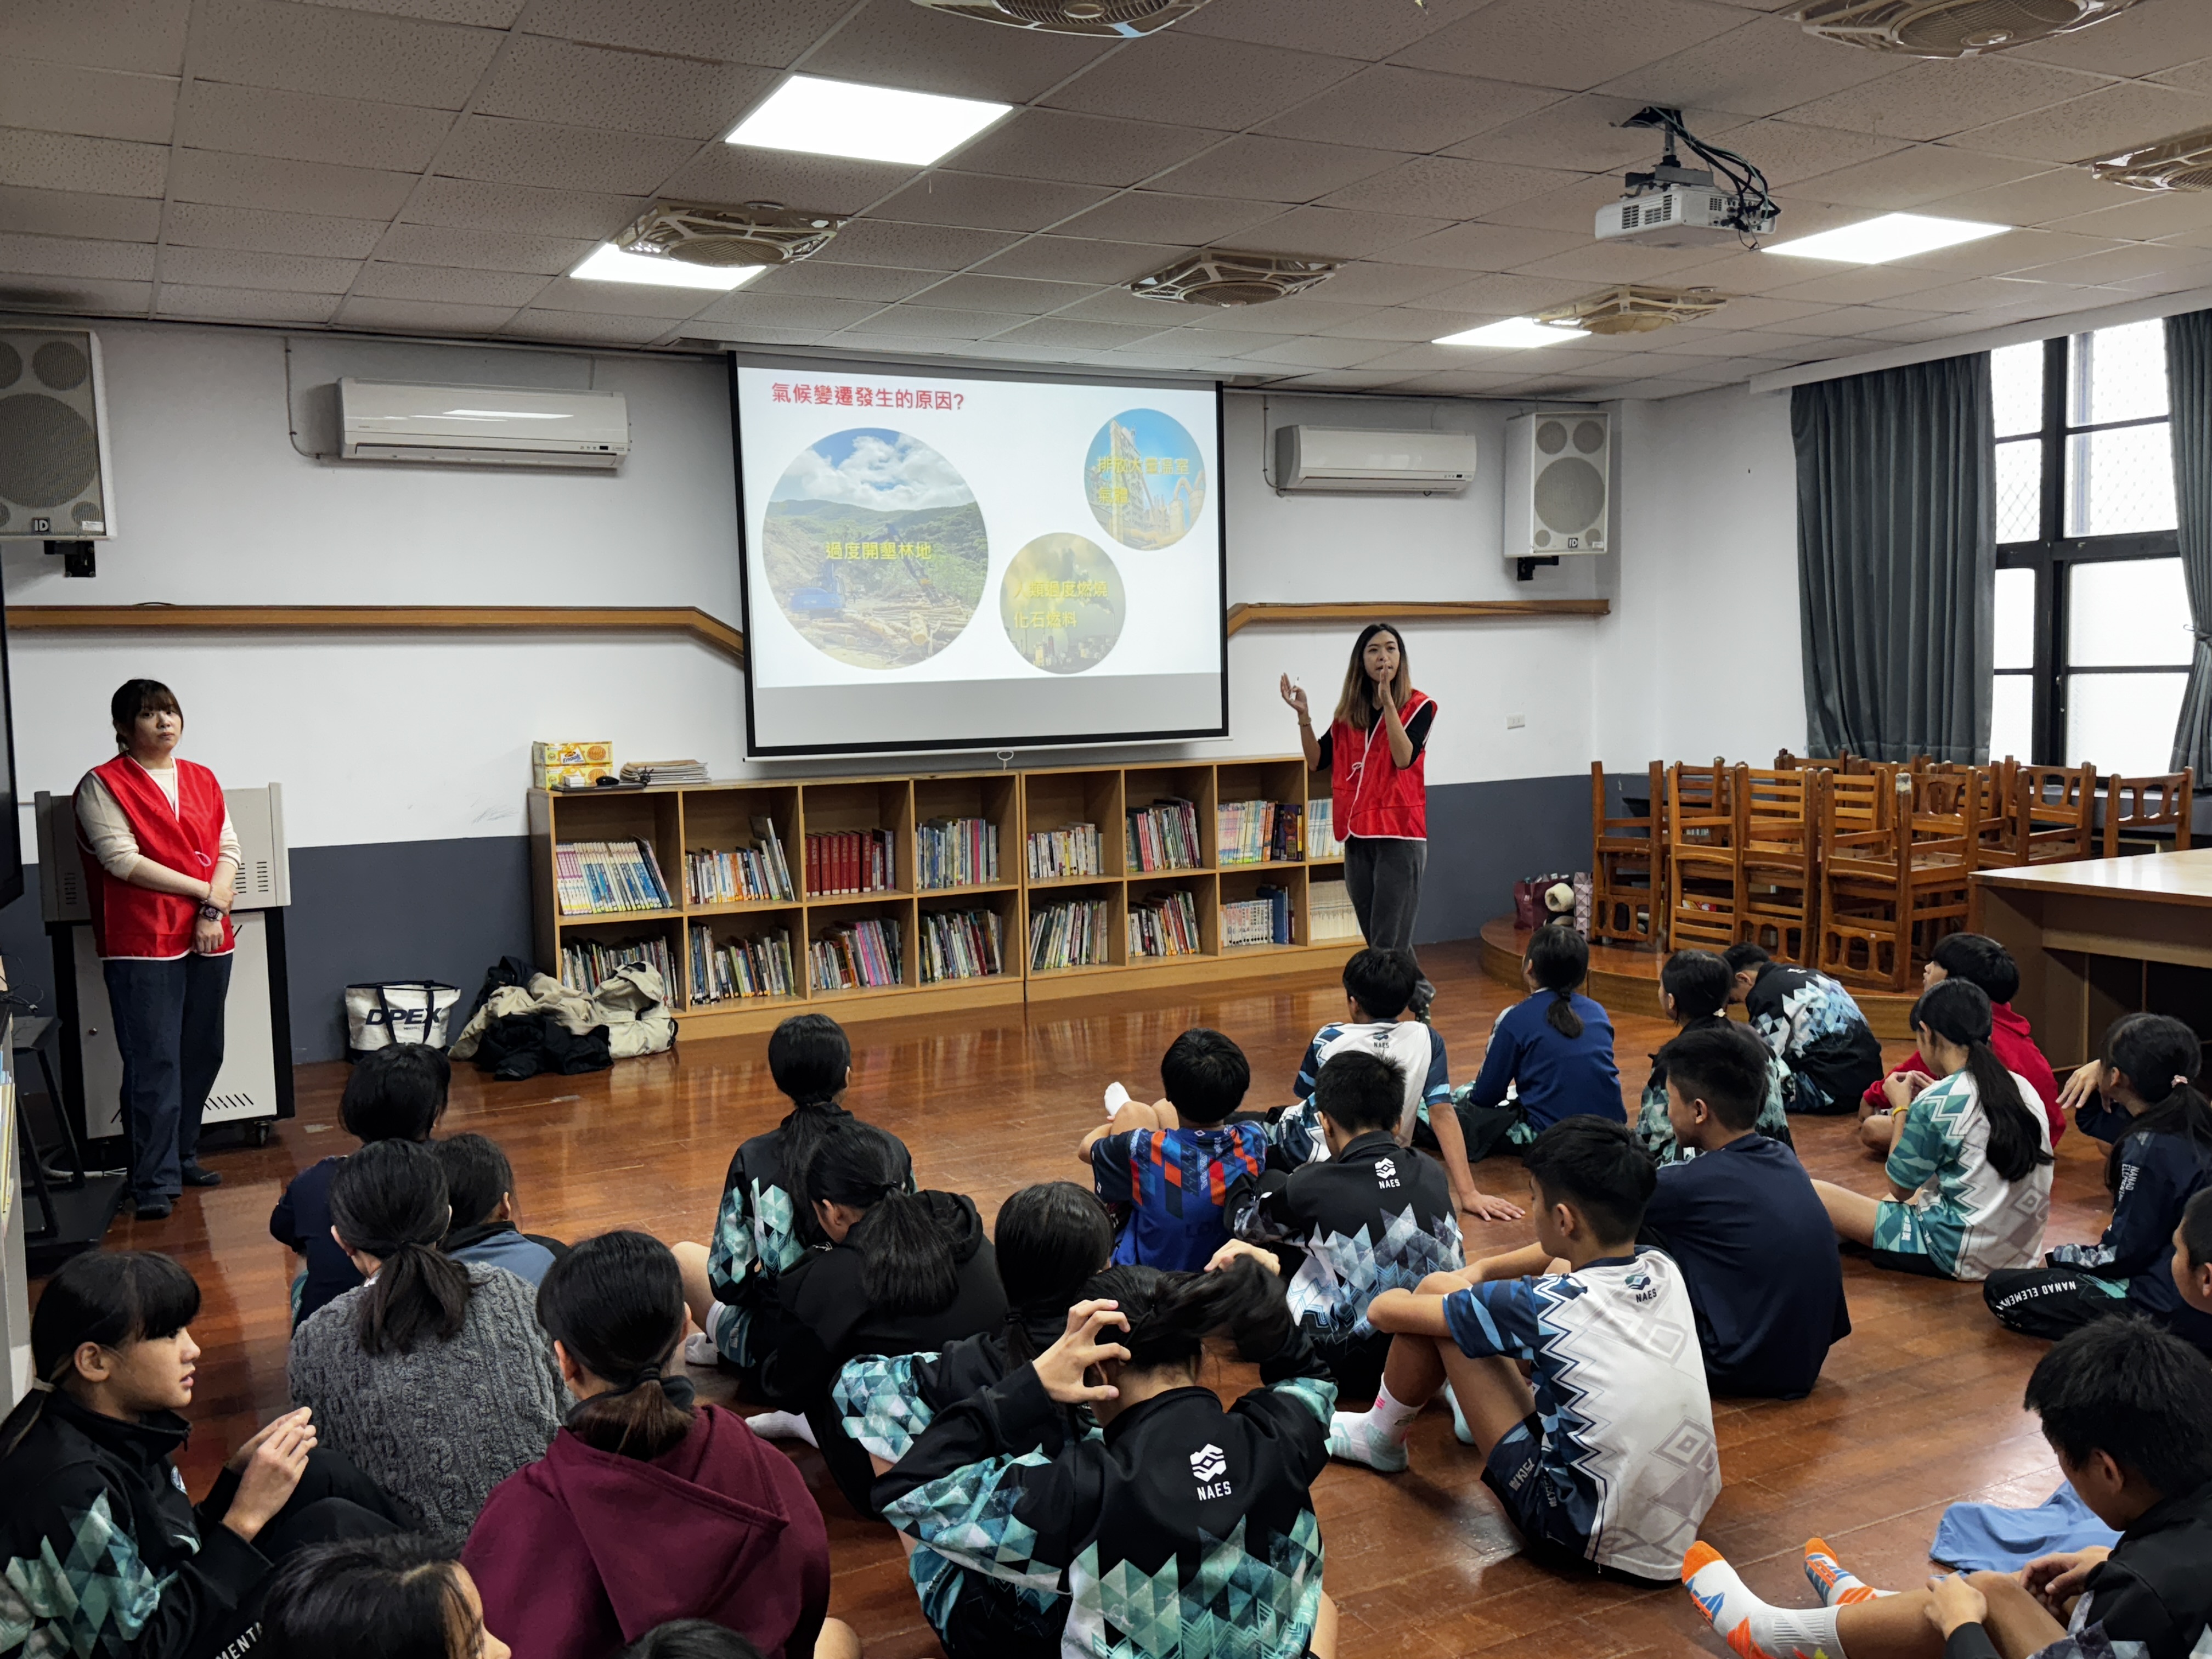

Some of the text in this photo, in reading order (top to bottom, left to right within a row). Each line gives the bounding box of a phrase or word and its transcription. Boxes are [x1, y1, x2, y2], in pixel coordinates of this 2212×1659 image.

[771, 382, 964, 410] 氣候變遷發生的原因?
[1097, 456, 1190, 475] 排放大量溫室
[35, 520, 49, 532] ID
[825, 541, 933, 560] 過度開墾林地
[1569, 539, 1577, 548] ID
[1014, 580, 1108, 598] 人類過度燃燒
[1013, 610, 1077, 629] 化石燃料
[1378, 1178, 1401, 1189] NAES
[1635, 1288, 1657, 1303] NAES
[2041, 1280, 2077, 1295] NANAO
[1197, 1481, 1232, 1501] NAES
